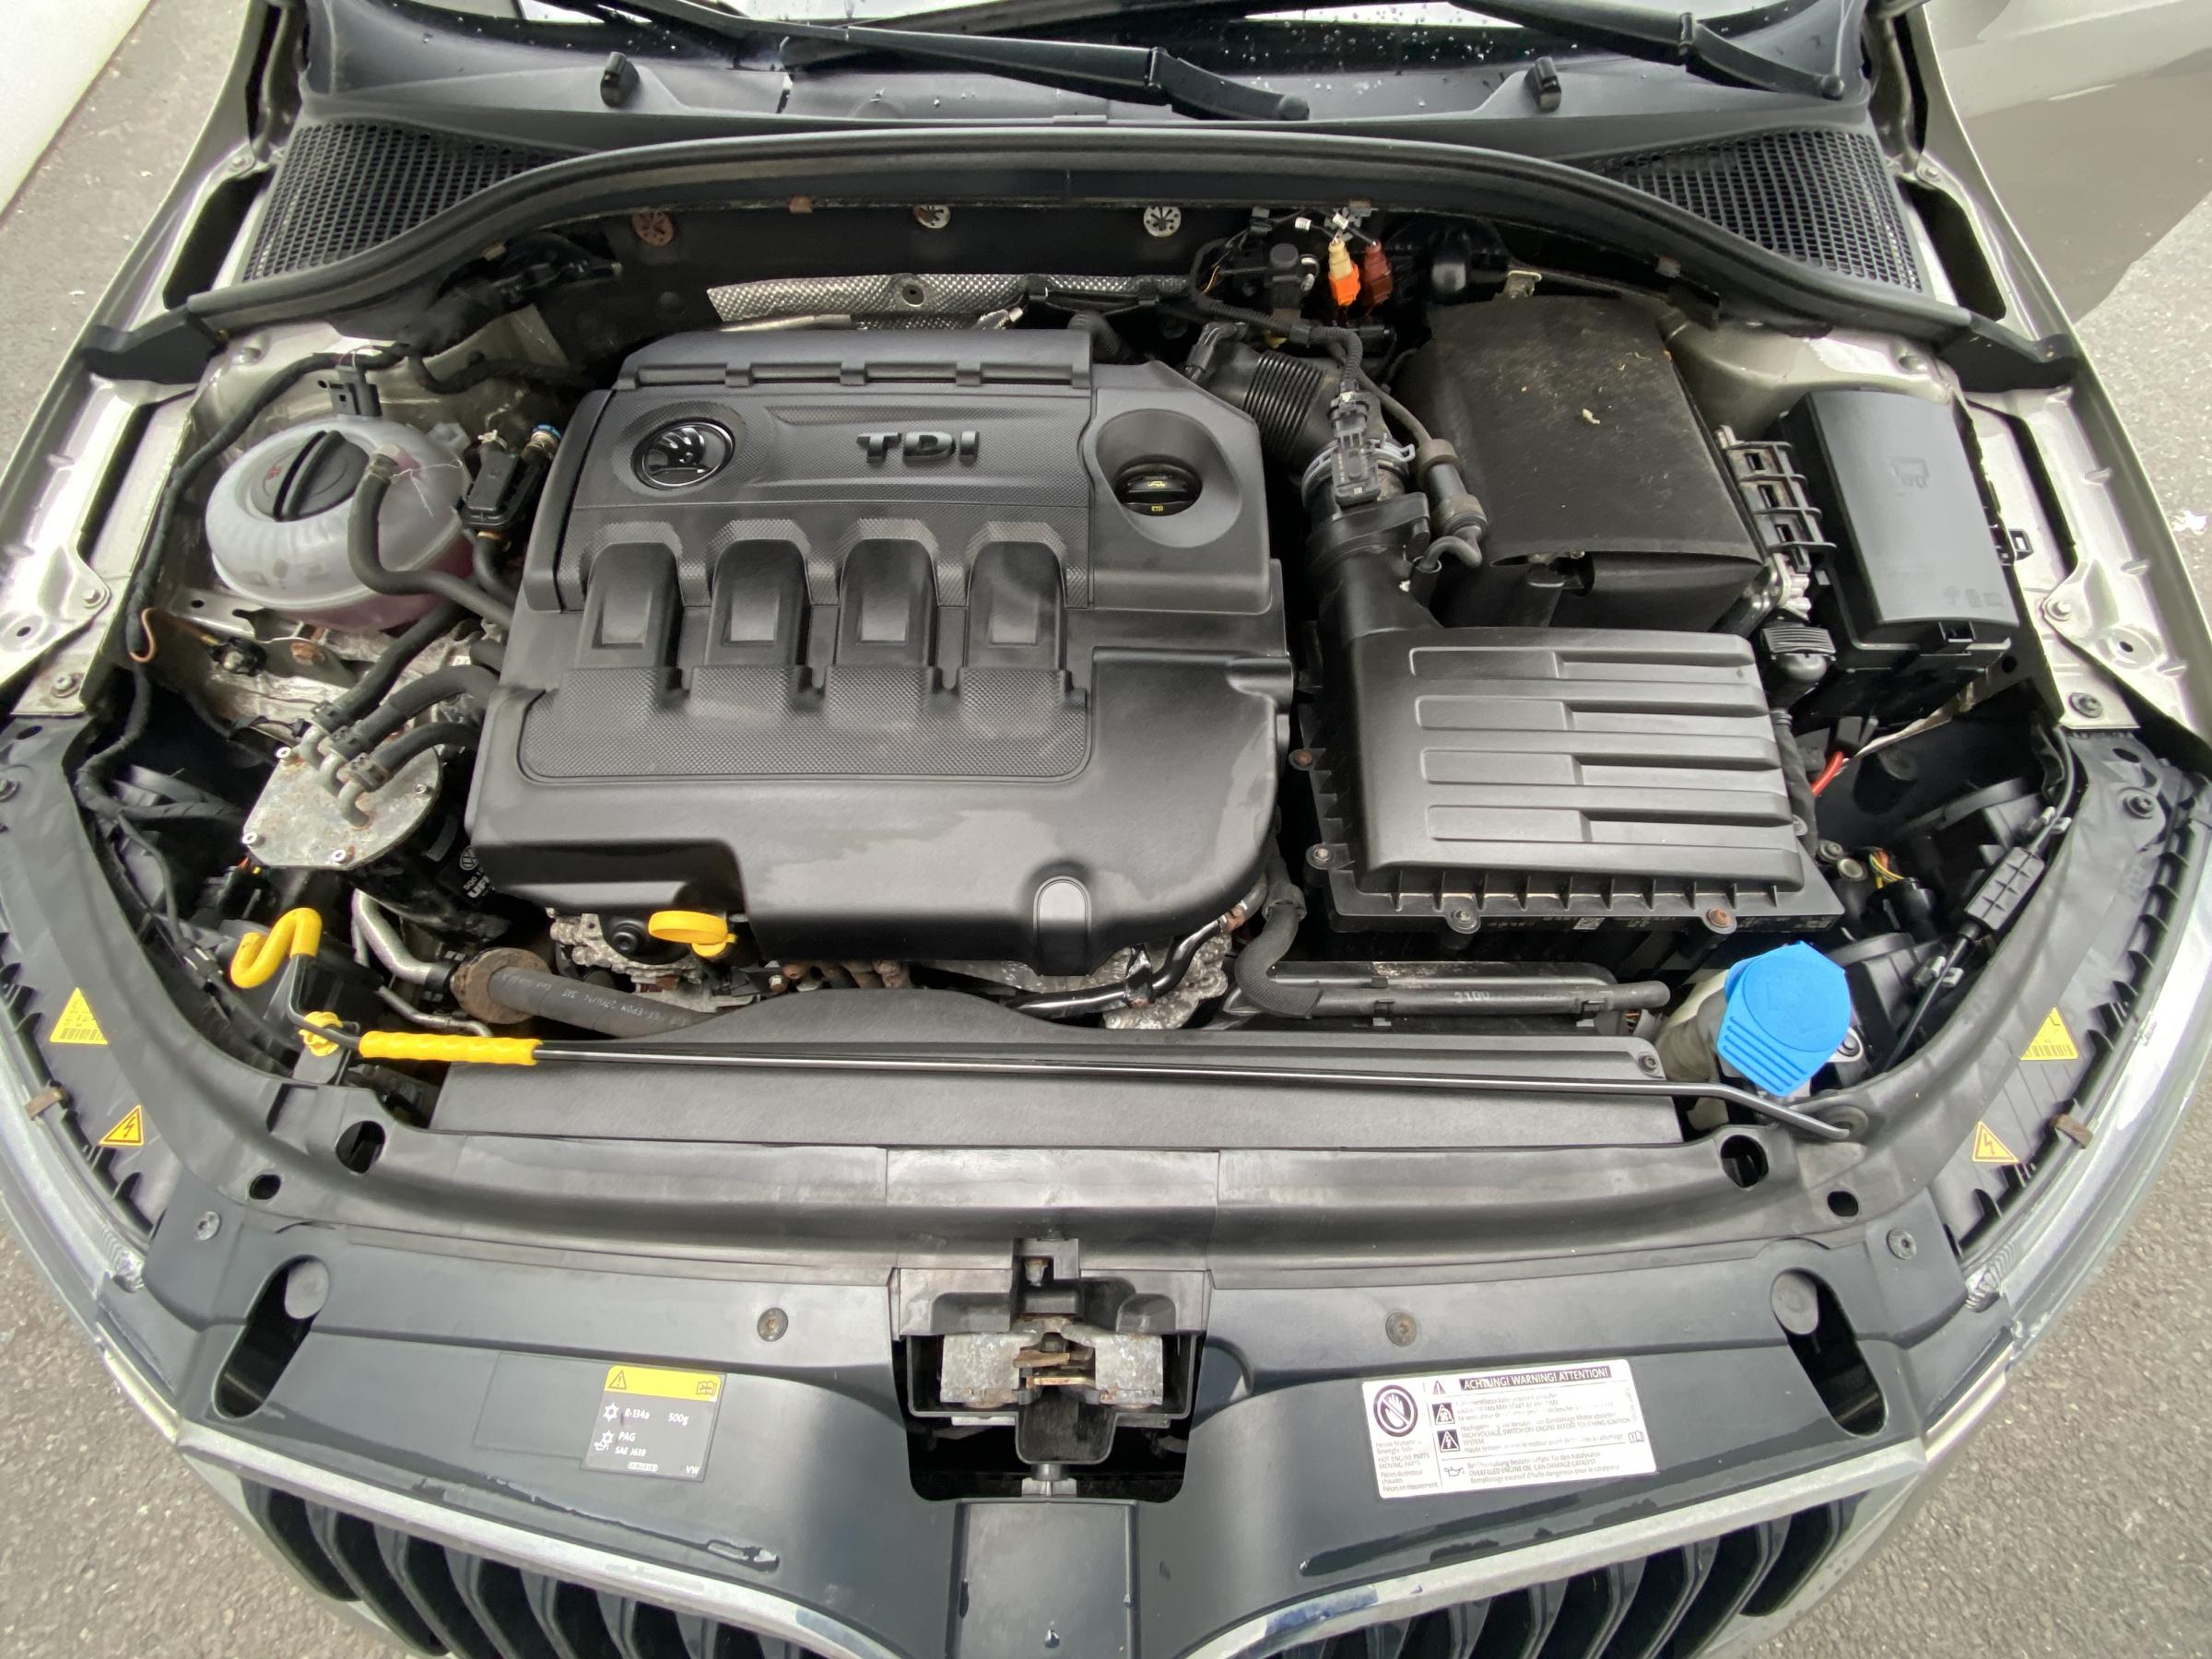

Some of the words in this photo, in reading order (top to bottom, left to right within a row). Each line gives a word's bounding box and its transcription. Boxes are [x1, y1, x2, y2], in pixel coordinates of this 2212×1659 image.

[857, 430, 979, 465] TDI
[1463, 1376, 1510, 1389] ACHTUNG!
[1511, 1372, 1557, 1384] WARNING!
[1557, 1367, 1608, 1380] ATTENTION!
[624, 1408, 650, 1419] R-134a
[668, 1413, 689, 1425] 500g
[619, 1431, 636, 1442] PAG
[615, 1446, 628, 1455] SAE
[686, 1465, 700, 1475] VW
[1546, 1461, 1570, 1469] DAMAGE
